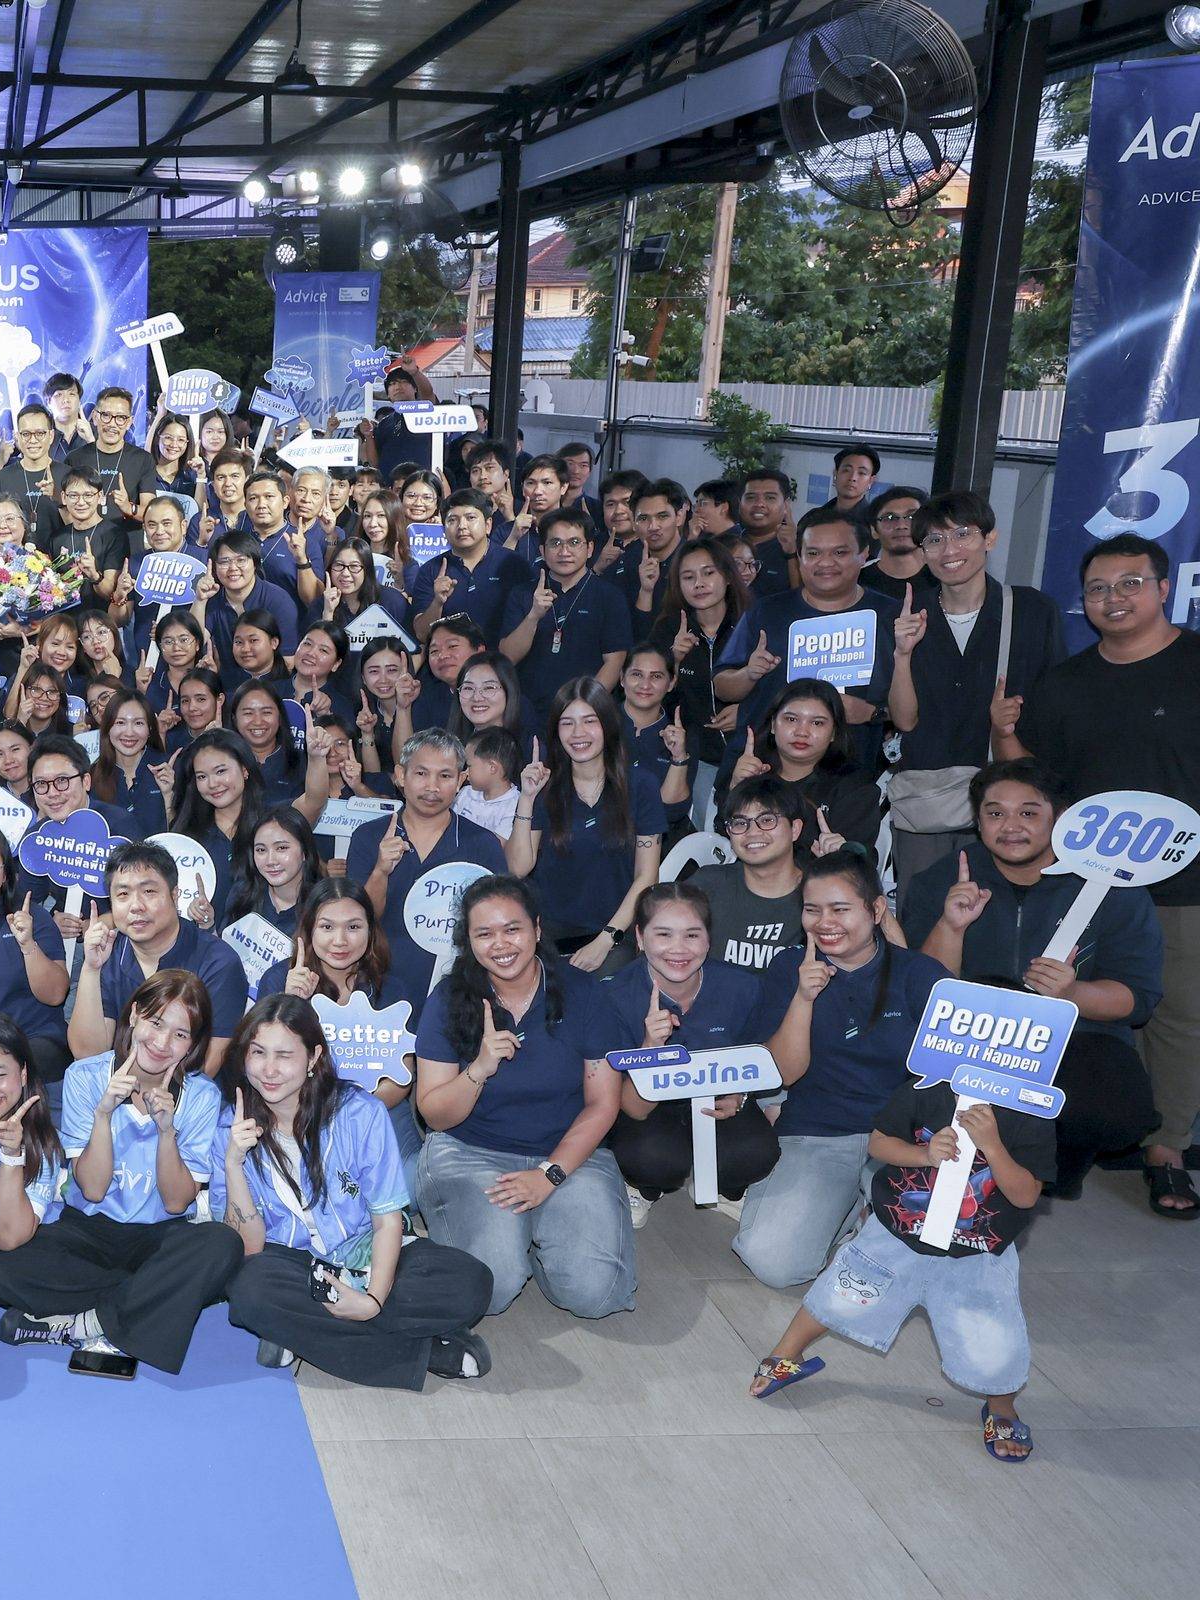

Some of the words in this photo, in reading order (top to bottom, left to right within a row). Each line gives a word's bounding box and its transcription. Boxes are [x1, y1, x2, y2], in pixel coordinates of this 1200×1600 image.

[1119, 114, 1200, 163] Ad
[283, 288, 328, 303] Advice
[131, 321, 174, 342] มองไกล
[354, 357, 383, 367] Better
[172, 375, 210, 390] Thrive
[170, 389, 208, 407] Shine
[415, 412, 467, 426] มองไกล
[147, 555, 193, 578] Thrive
[141, 573, 187, 596] Shine
[793, 626, 866, 656] People
[793, 655, 818, 668] Make
[820, 654, 828, 665] It
[830, 651, 865, 665] Happen
[821, 671, 852, 682] Advice
[1063, 805, 1175, 863] 360
[1173, 831, 1197, 845] OF
[1161, 848, 1186, 863] US
[59, 869, 81, 880] Advice
[1082, 859, 1112, 873] Advice
[414, 914, 457, 933] Purp
[746, 922, 784, 941] 1773
[246, 957, 265, 973] Advic
[323, 1022, 403, 1044] Better
[928, 999, 1052, 1053] People
[328, 1043, 398, 1058] Together
[922, 1034, 964, 1055] Make
[967, 1043, 980, 1059] It
[982, 1047, 1041, 1073] Happen
[339, 1061, 363, 1069] Advice
[618, 1054, 652, 1065] Advice
[652, 1062, 759, 1090] มองไกล
[958, 1074, 1010, 1096] Advice
